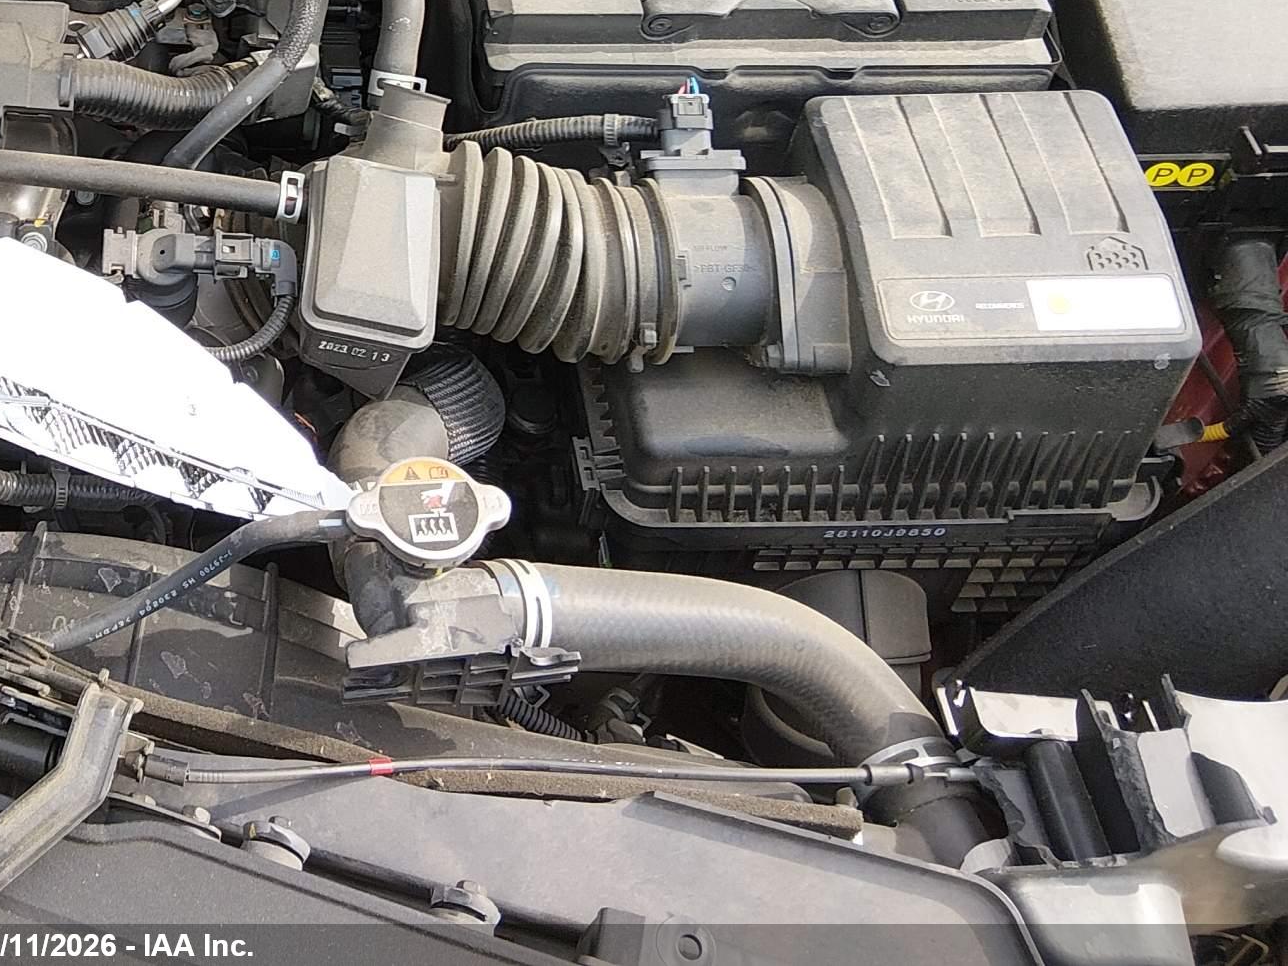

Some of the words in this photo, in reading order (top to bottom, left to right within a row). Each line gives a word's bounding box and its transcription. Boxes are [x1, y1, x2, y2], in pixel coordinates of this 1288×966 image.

[907, 314, 965, 323] HYUNDAI
[318, 340, 348, 354] 2023
[350, 347, 367, 358] 02
[181, 577, 197, 589] HS
